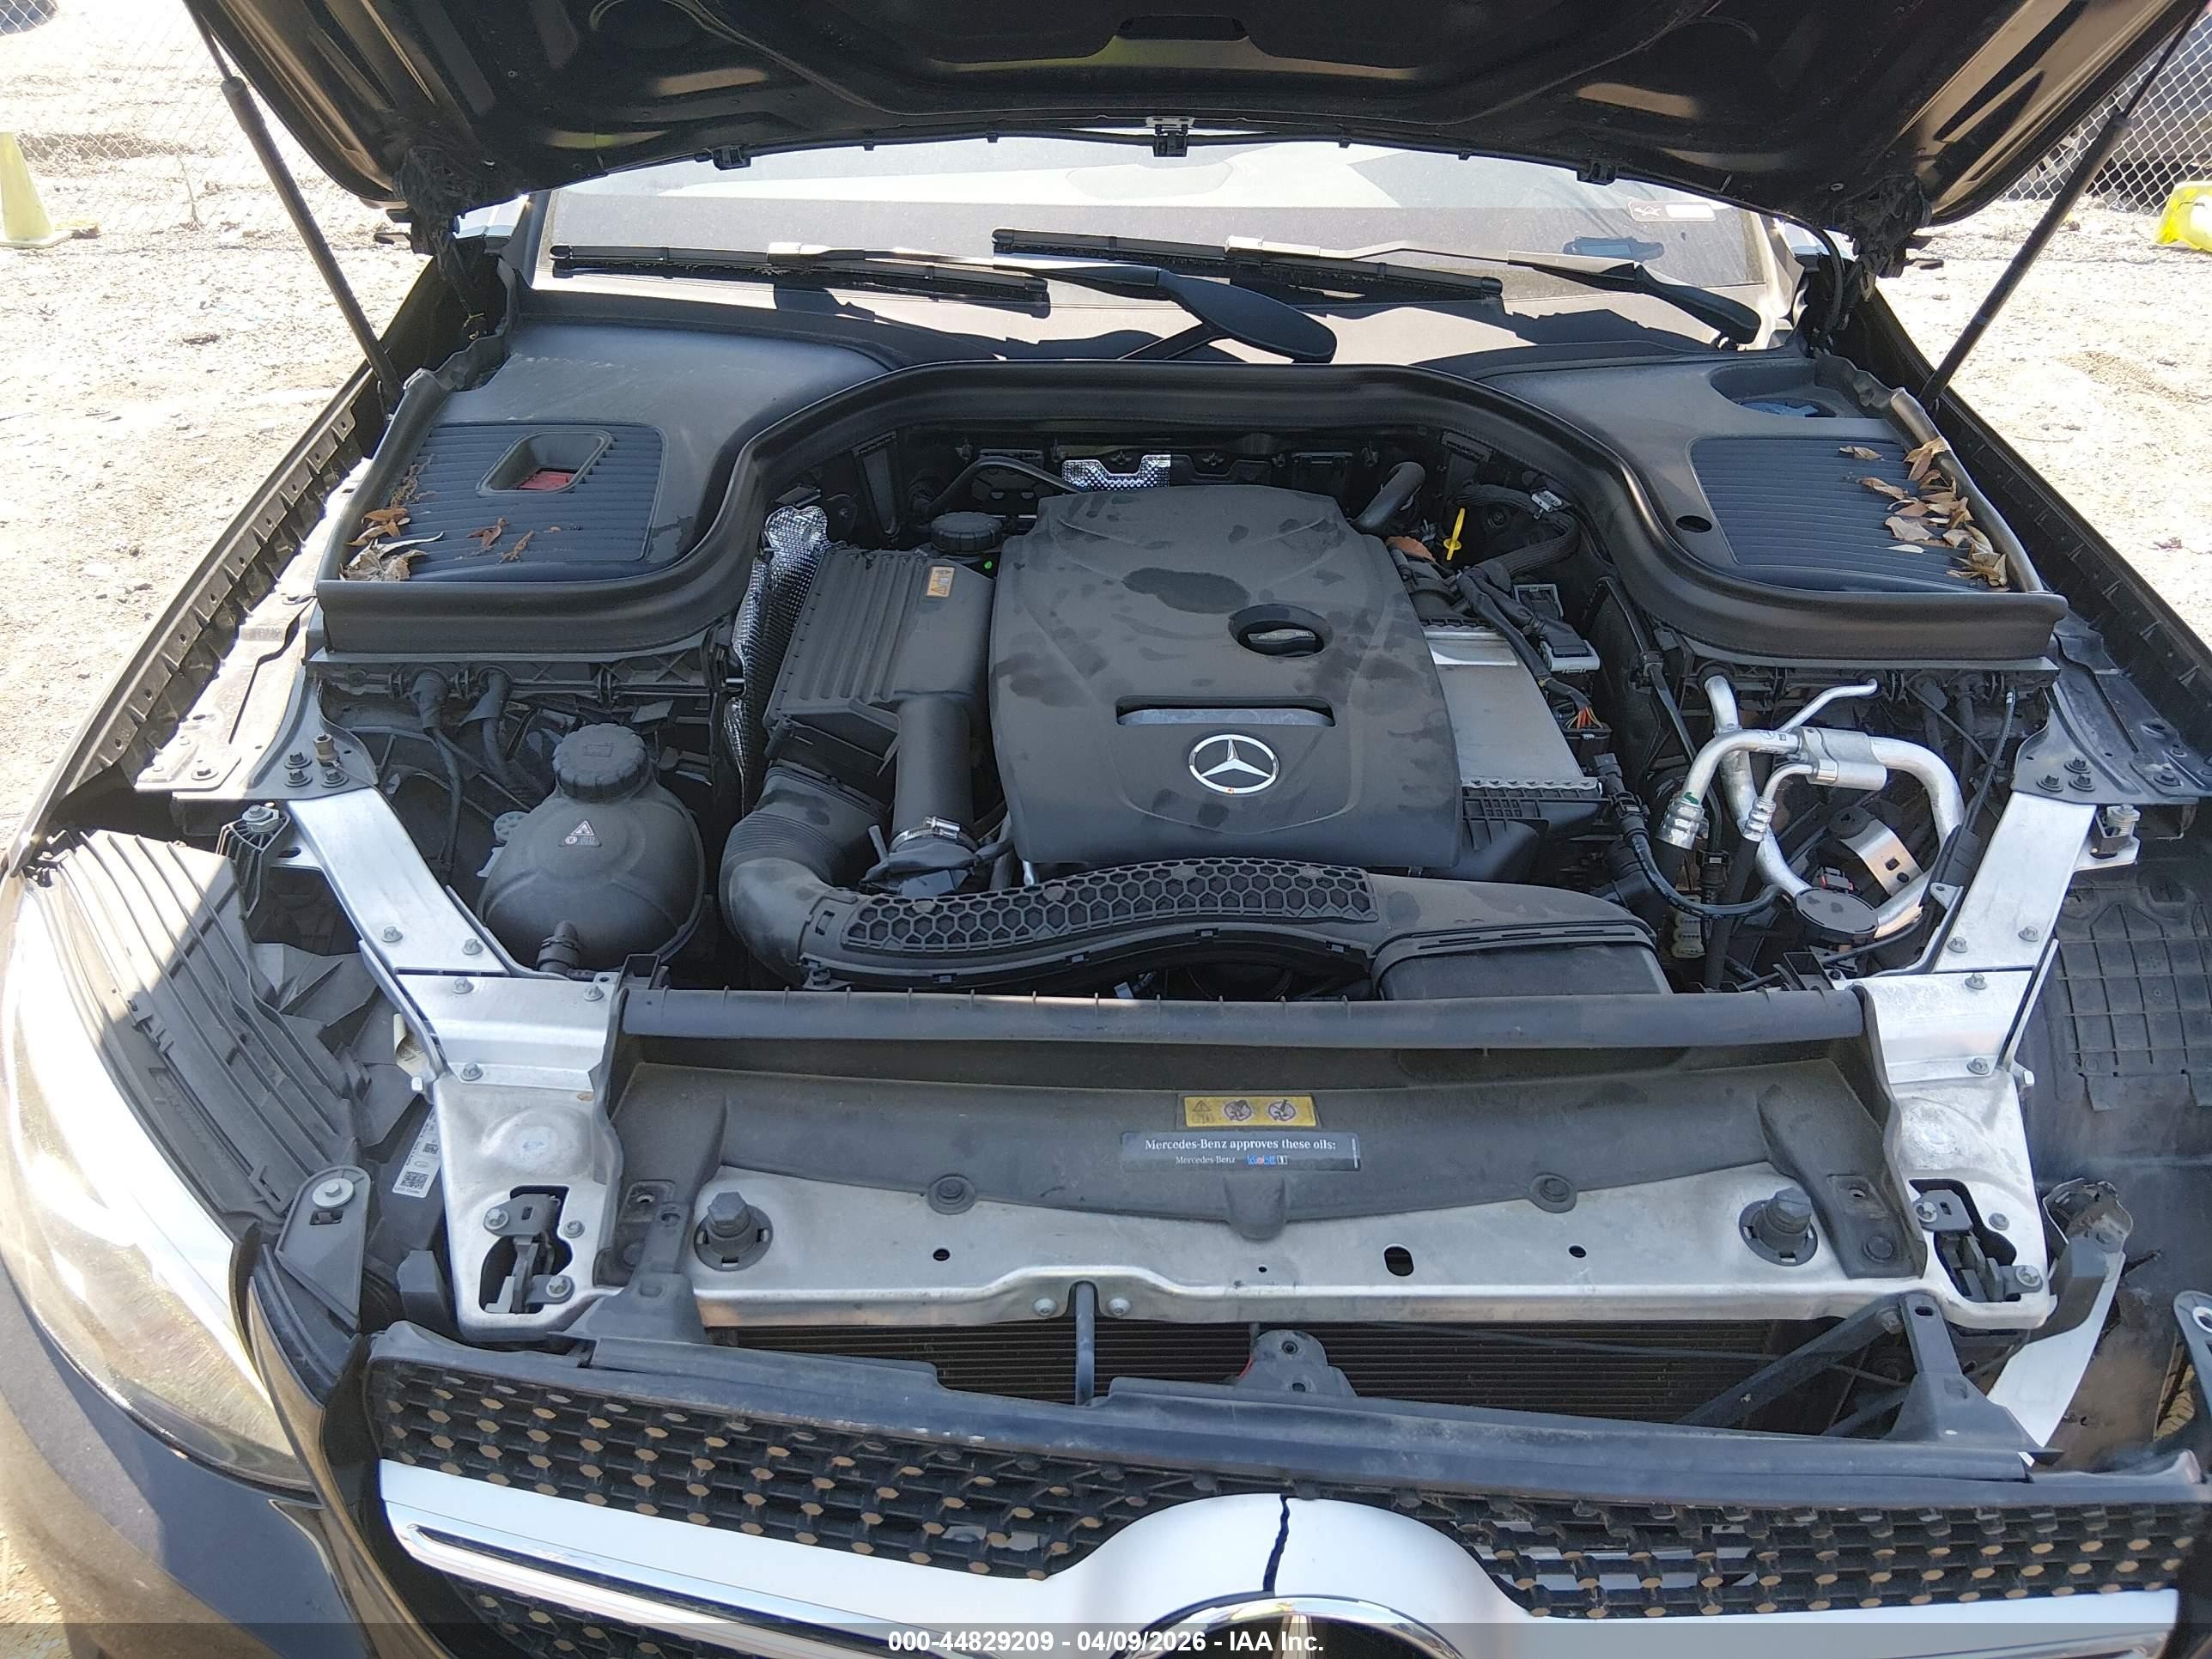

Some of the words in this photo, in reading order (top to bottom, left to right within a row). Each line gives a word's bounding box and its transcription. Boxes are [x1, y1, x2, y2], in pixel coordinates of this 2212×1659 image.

[1145, 1139, 1227, 1150] Mercedes-Benz
[1230, 1139, 1279, 1151] approves
[1281, 1139, 1311, 1149] these
[1313, 1139, 1336, 1150] oils:
